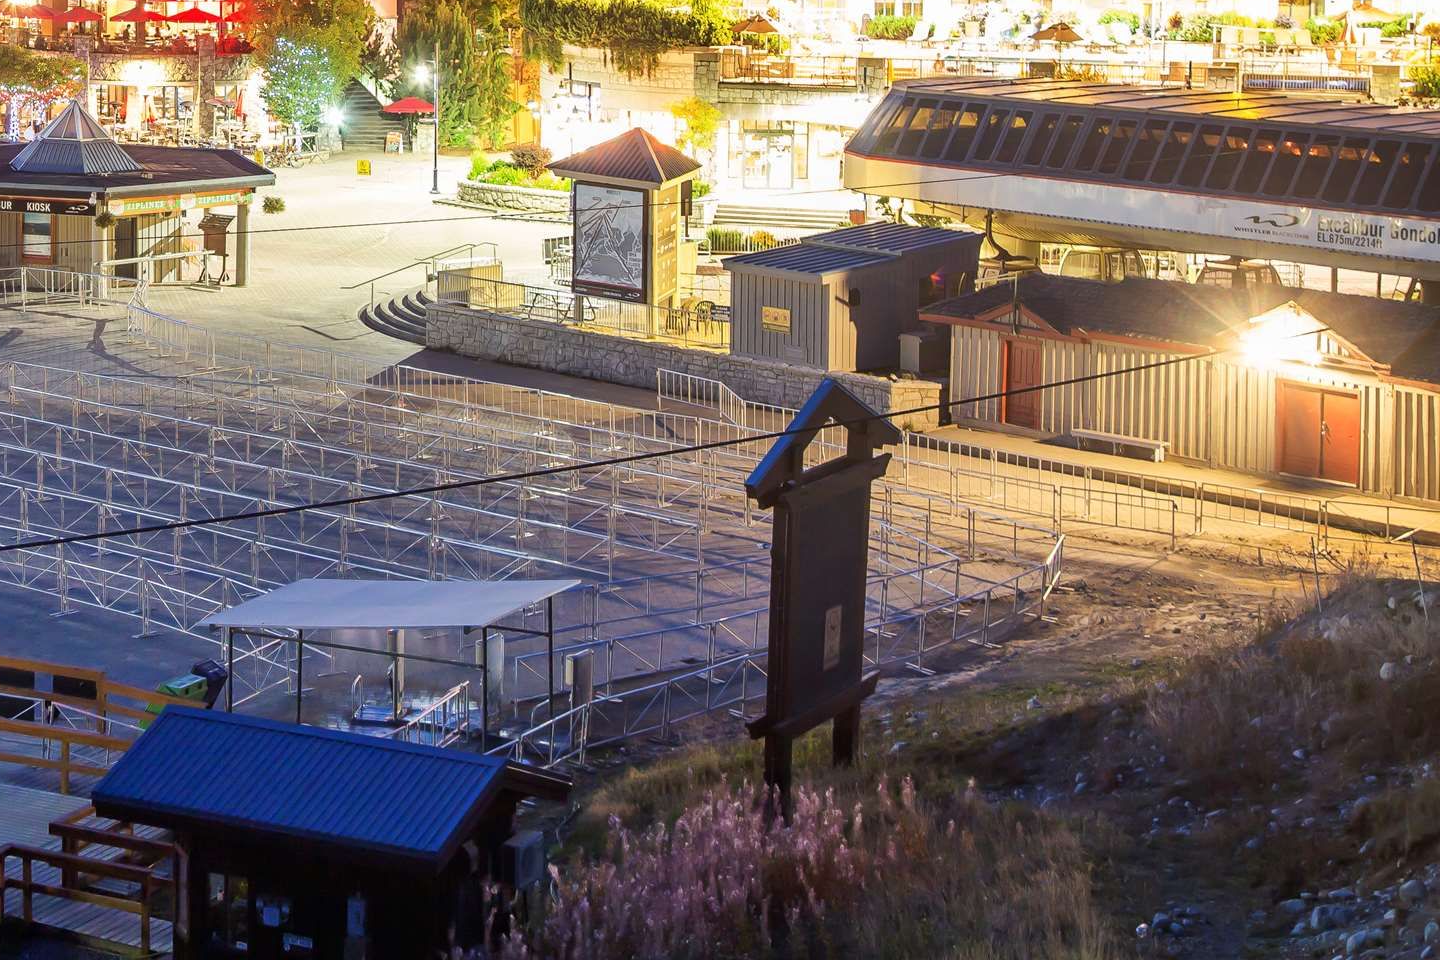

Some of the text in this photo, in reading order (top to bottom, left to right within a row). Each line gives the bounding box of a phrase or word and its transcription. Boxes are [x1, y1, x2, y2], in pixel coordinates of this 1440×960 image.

[26, 202, 51, 213] KIOSK
[1234, 225, 1271, 235] WHISTLER
[1318, 215, 1385, 238] Excalibur
